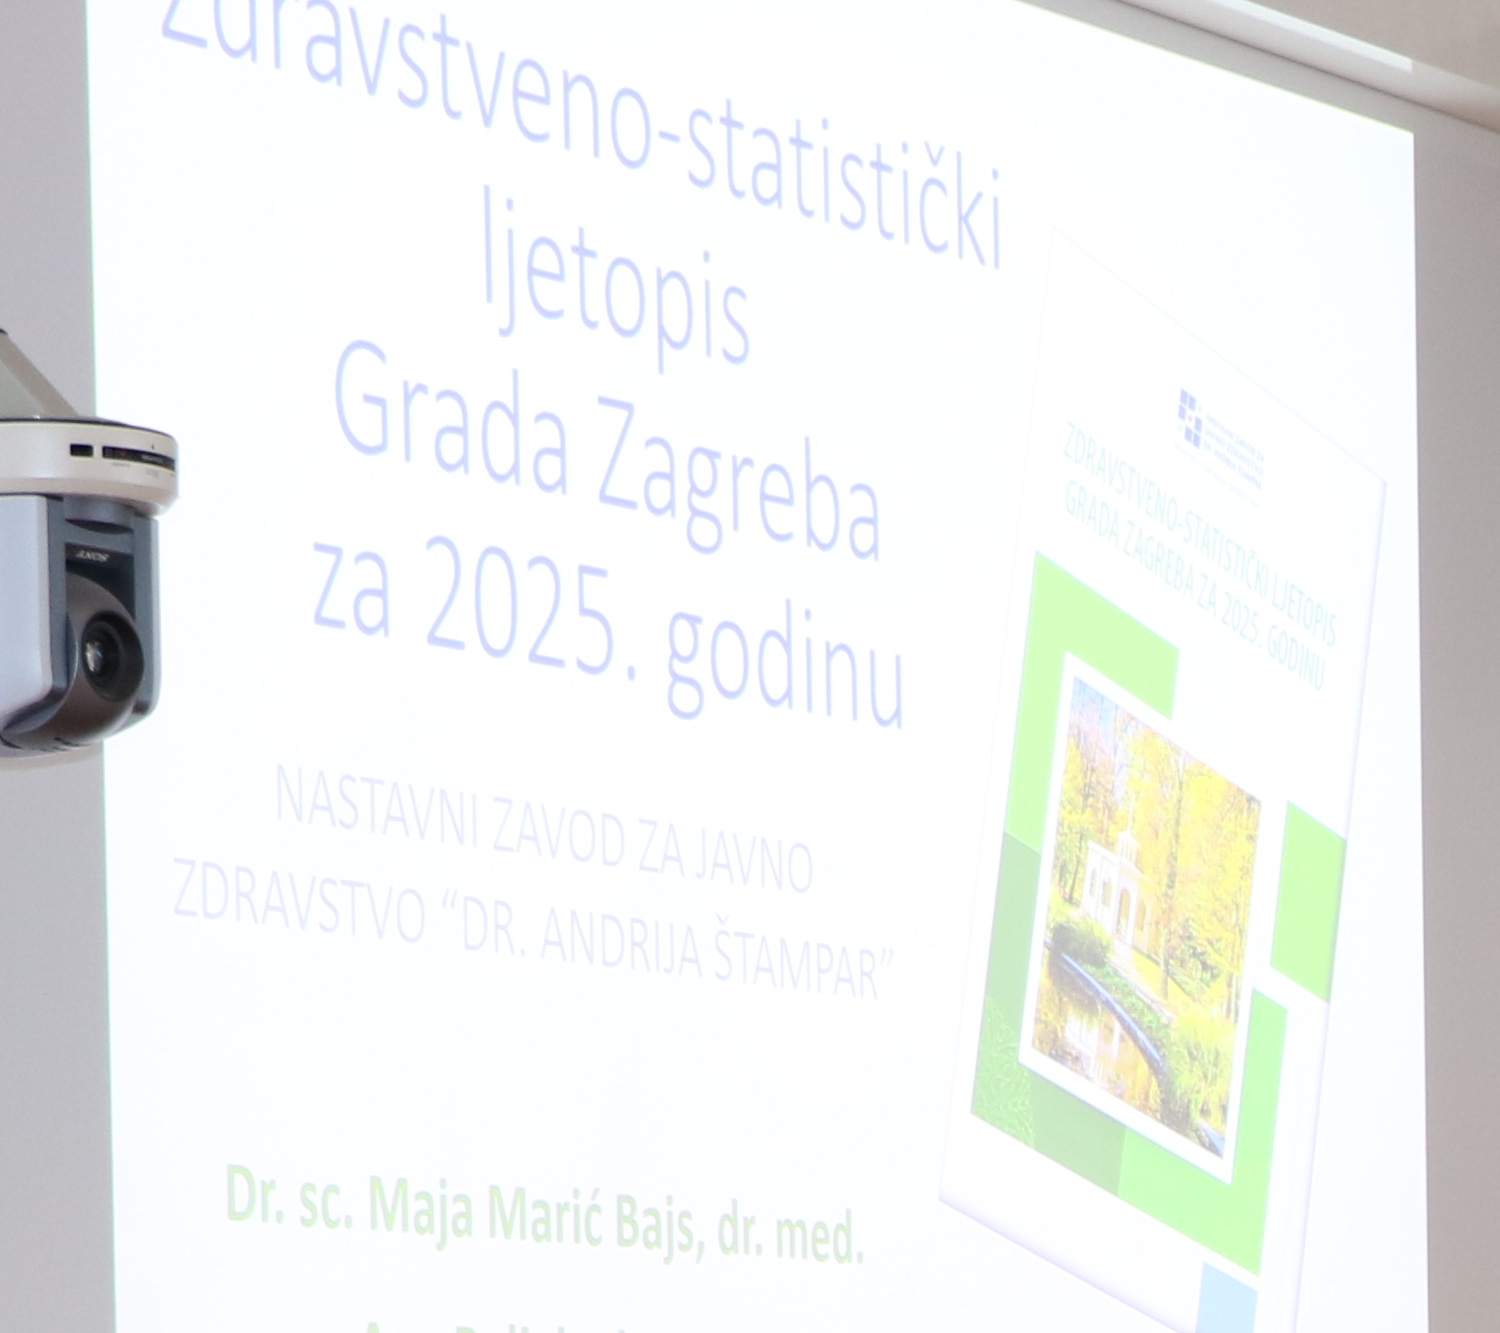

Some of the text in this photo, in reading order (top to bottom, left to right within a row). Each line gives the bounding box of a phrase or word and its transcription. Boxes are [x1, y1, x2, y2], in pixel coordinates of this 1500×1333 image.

[483, 183, 751, 375] ljetopis
[334, 338, 881, 562] Grada Zagreba
[312, 534, 903, 730] za 2025. godinu
[1065, 478, 1120, 548] GRADA
[1122, 518, 1194, 601] ZAGREBA
[1196, 571, 1217, 618] ZA
[1267, 622, 1326, 692] GODINU
[1271, 571, 1338, 648] LJETOPIS
[275, 762, 815, 895] NASTAVNI ZAVOD ZA JAVNO
[171, 856, 427, 945] ZDRAVSTVO
[539, 905, 704, 979] ANDRIJA
[225, 1162, 866, 1266] Dr. sc. Maja Marić Bajs, dr. med.
